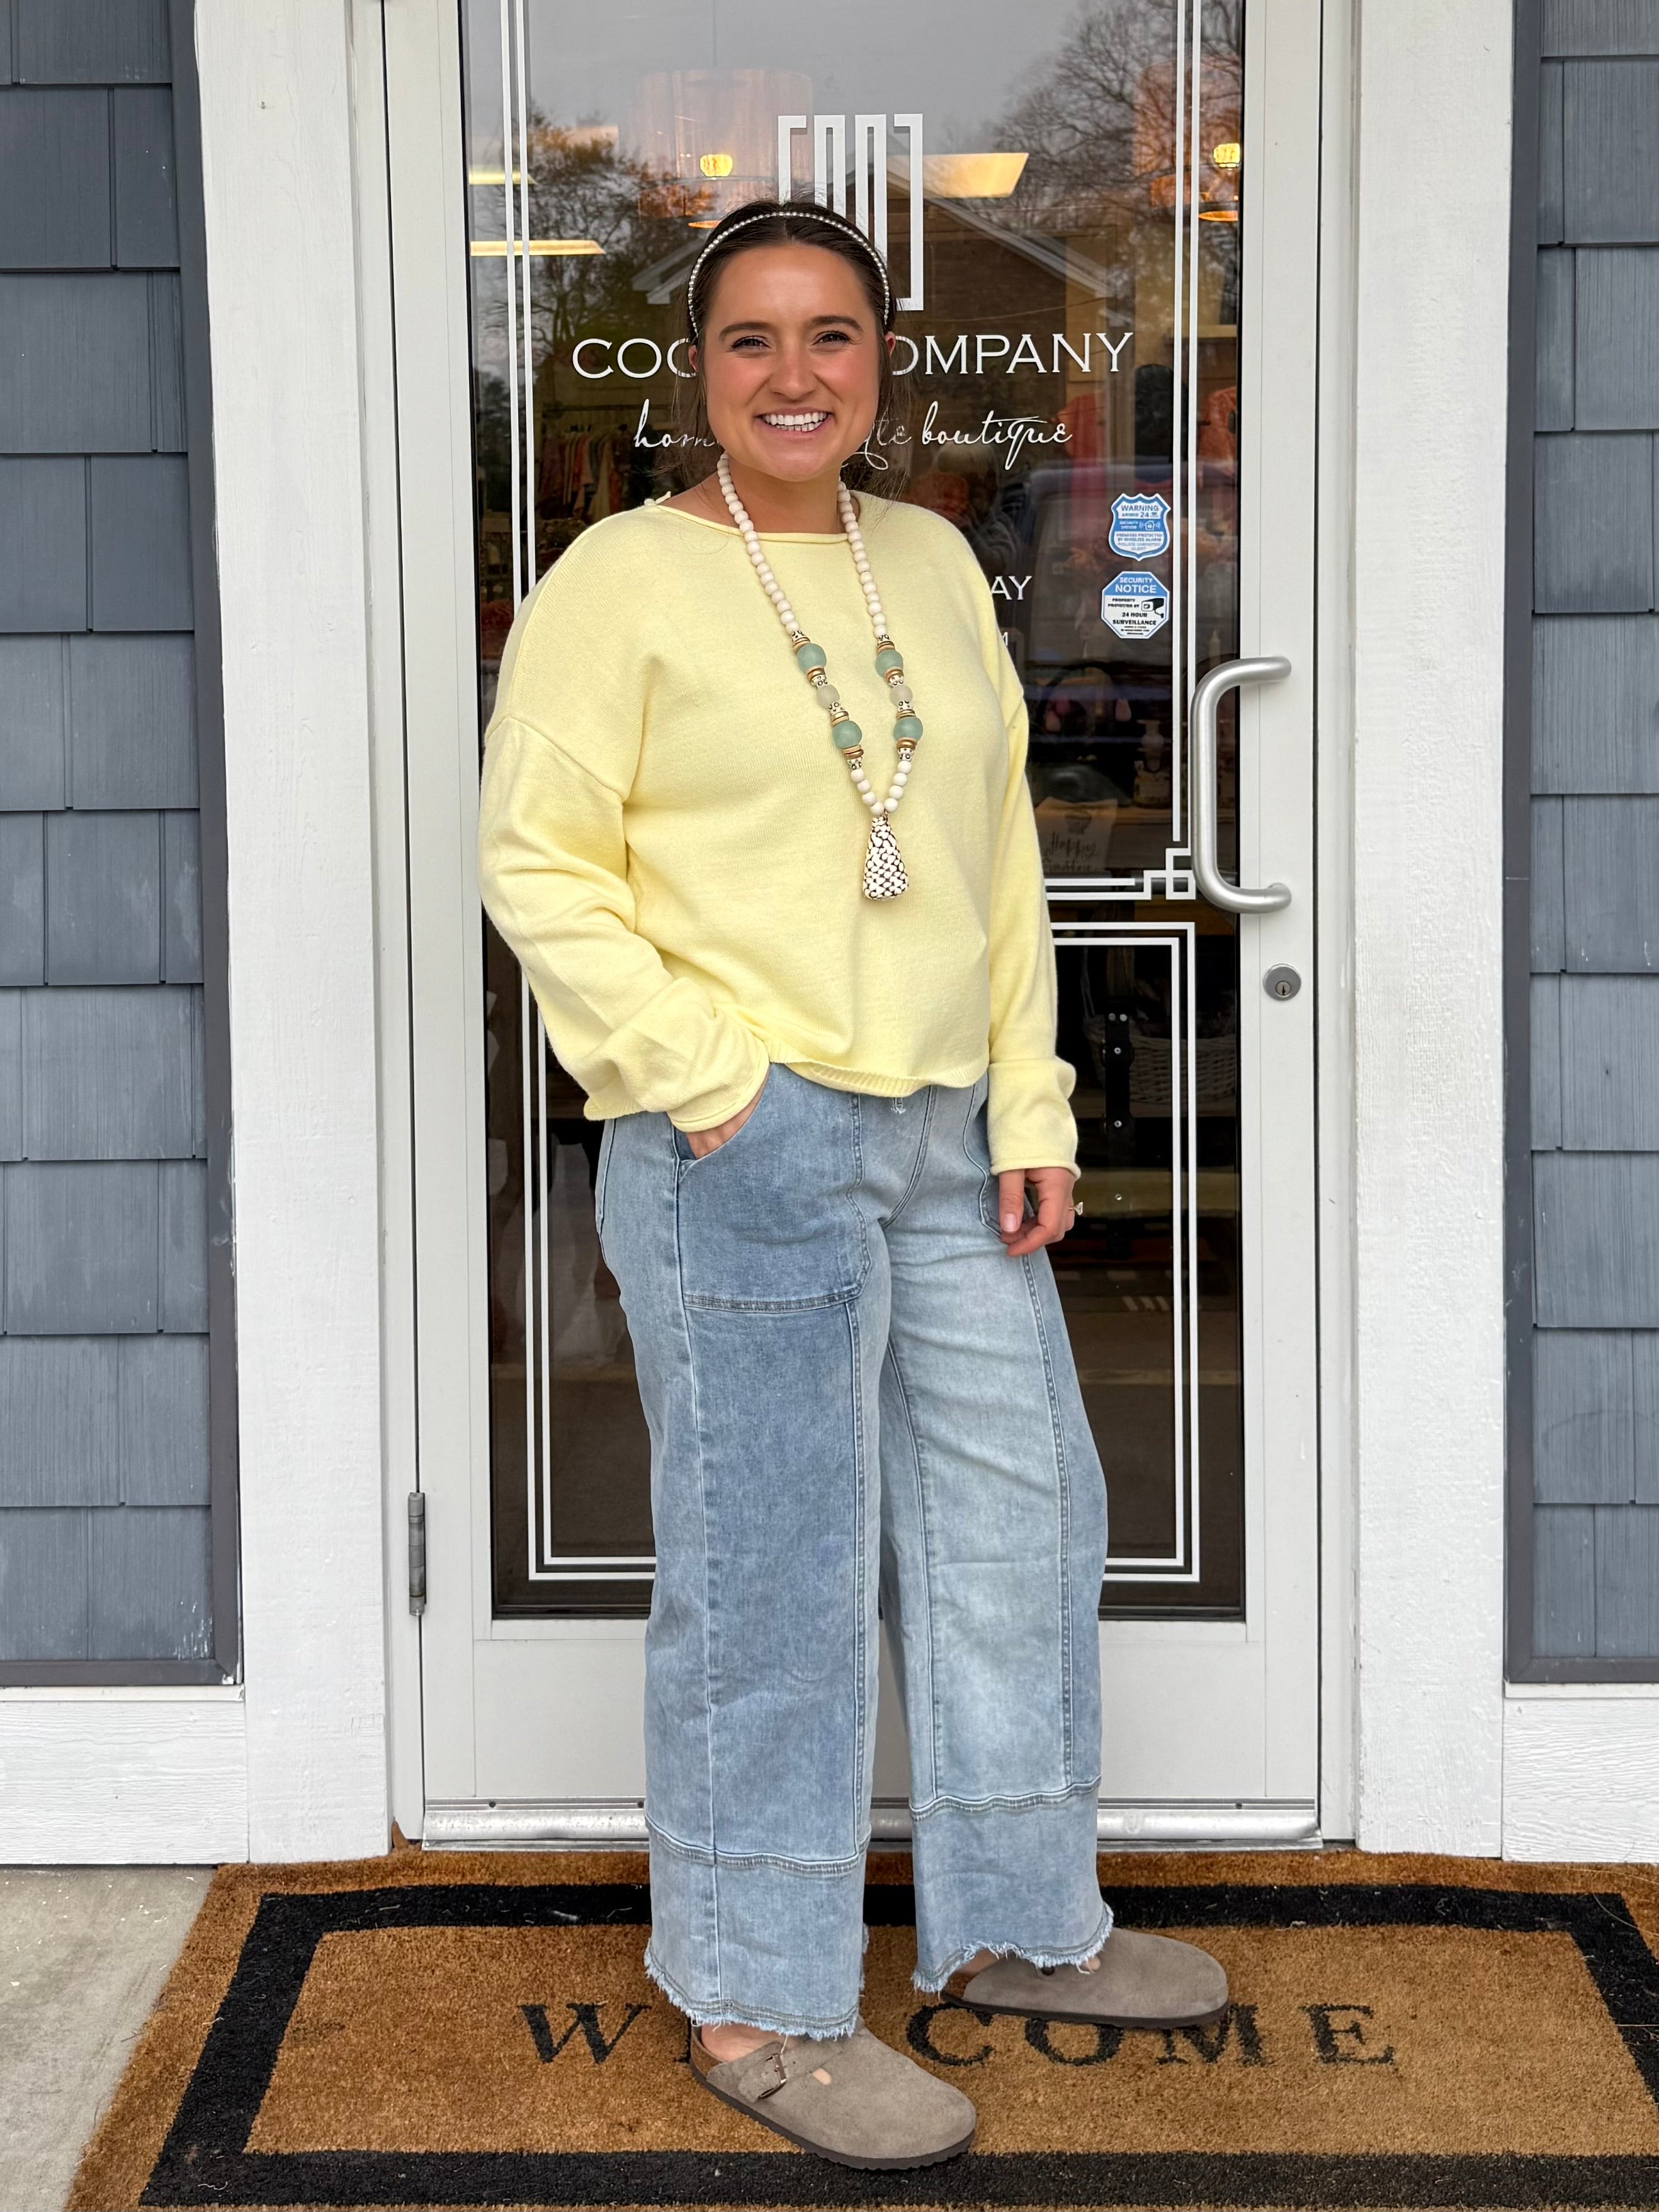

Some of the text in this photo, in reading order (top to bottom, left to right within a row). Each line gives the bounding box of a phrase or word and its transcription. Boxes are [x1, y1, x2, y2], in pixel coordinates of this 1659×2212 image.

[892, 332, 1133, 377] OMPANY
[634, 399, 723, 448] hom
[922, 400, 1073, 470] boutique
[1115, 584, 1157, 593] NOTICE
[516, 2001, 1394, 2067] WCOME
